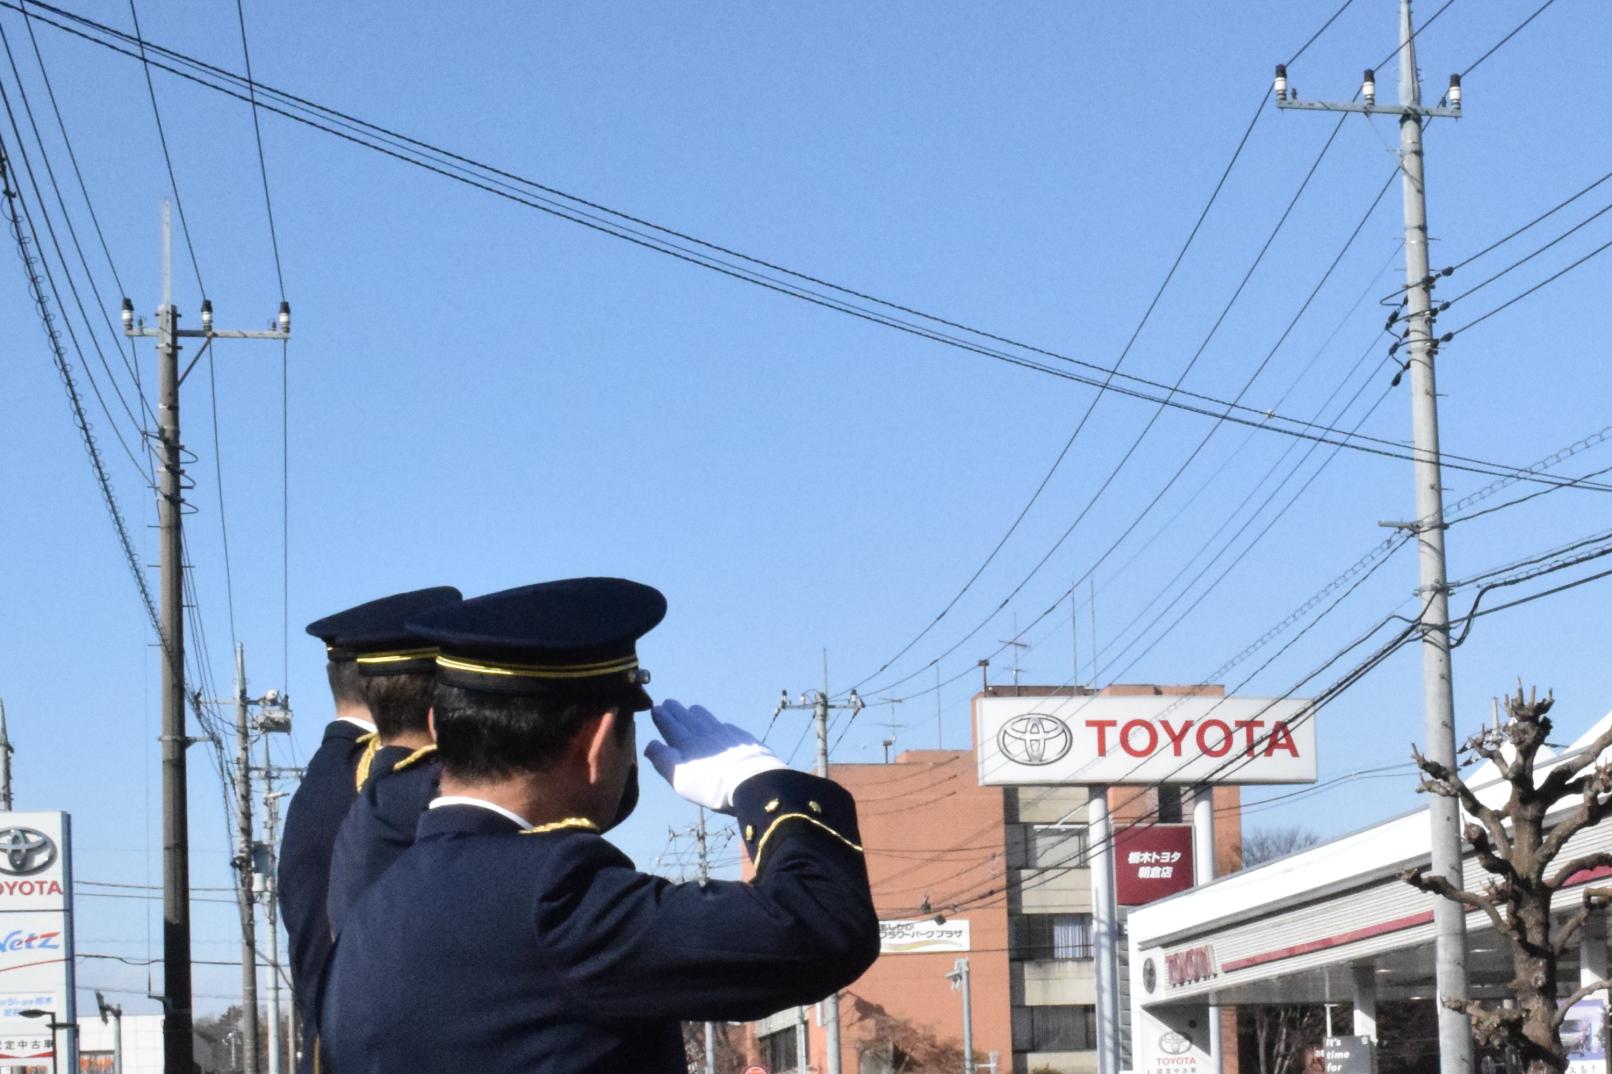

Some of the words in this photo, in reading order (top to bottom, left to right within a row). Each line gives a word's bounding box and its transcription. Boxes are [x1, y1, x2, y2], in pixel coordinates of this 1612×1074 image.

[1085, 718, 1300, 758] TOYOTA
[1128, 851, 1181, 865] 栃木トヨタ
[1138, 866, 1174, 879] 朝倉店
[0, 880, 63, 895] YOTA
[1157, 1057, 1197, 1065] TOYOTA
[1326, 1050, 1350, 1059] time
[1327, 1062, 1342, 1072] for
